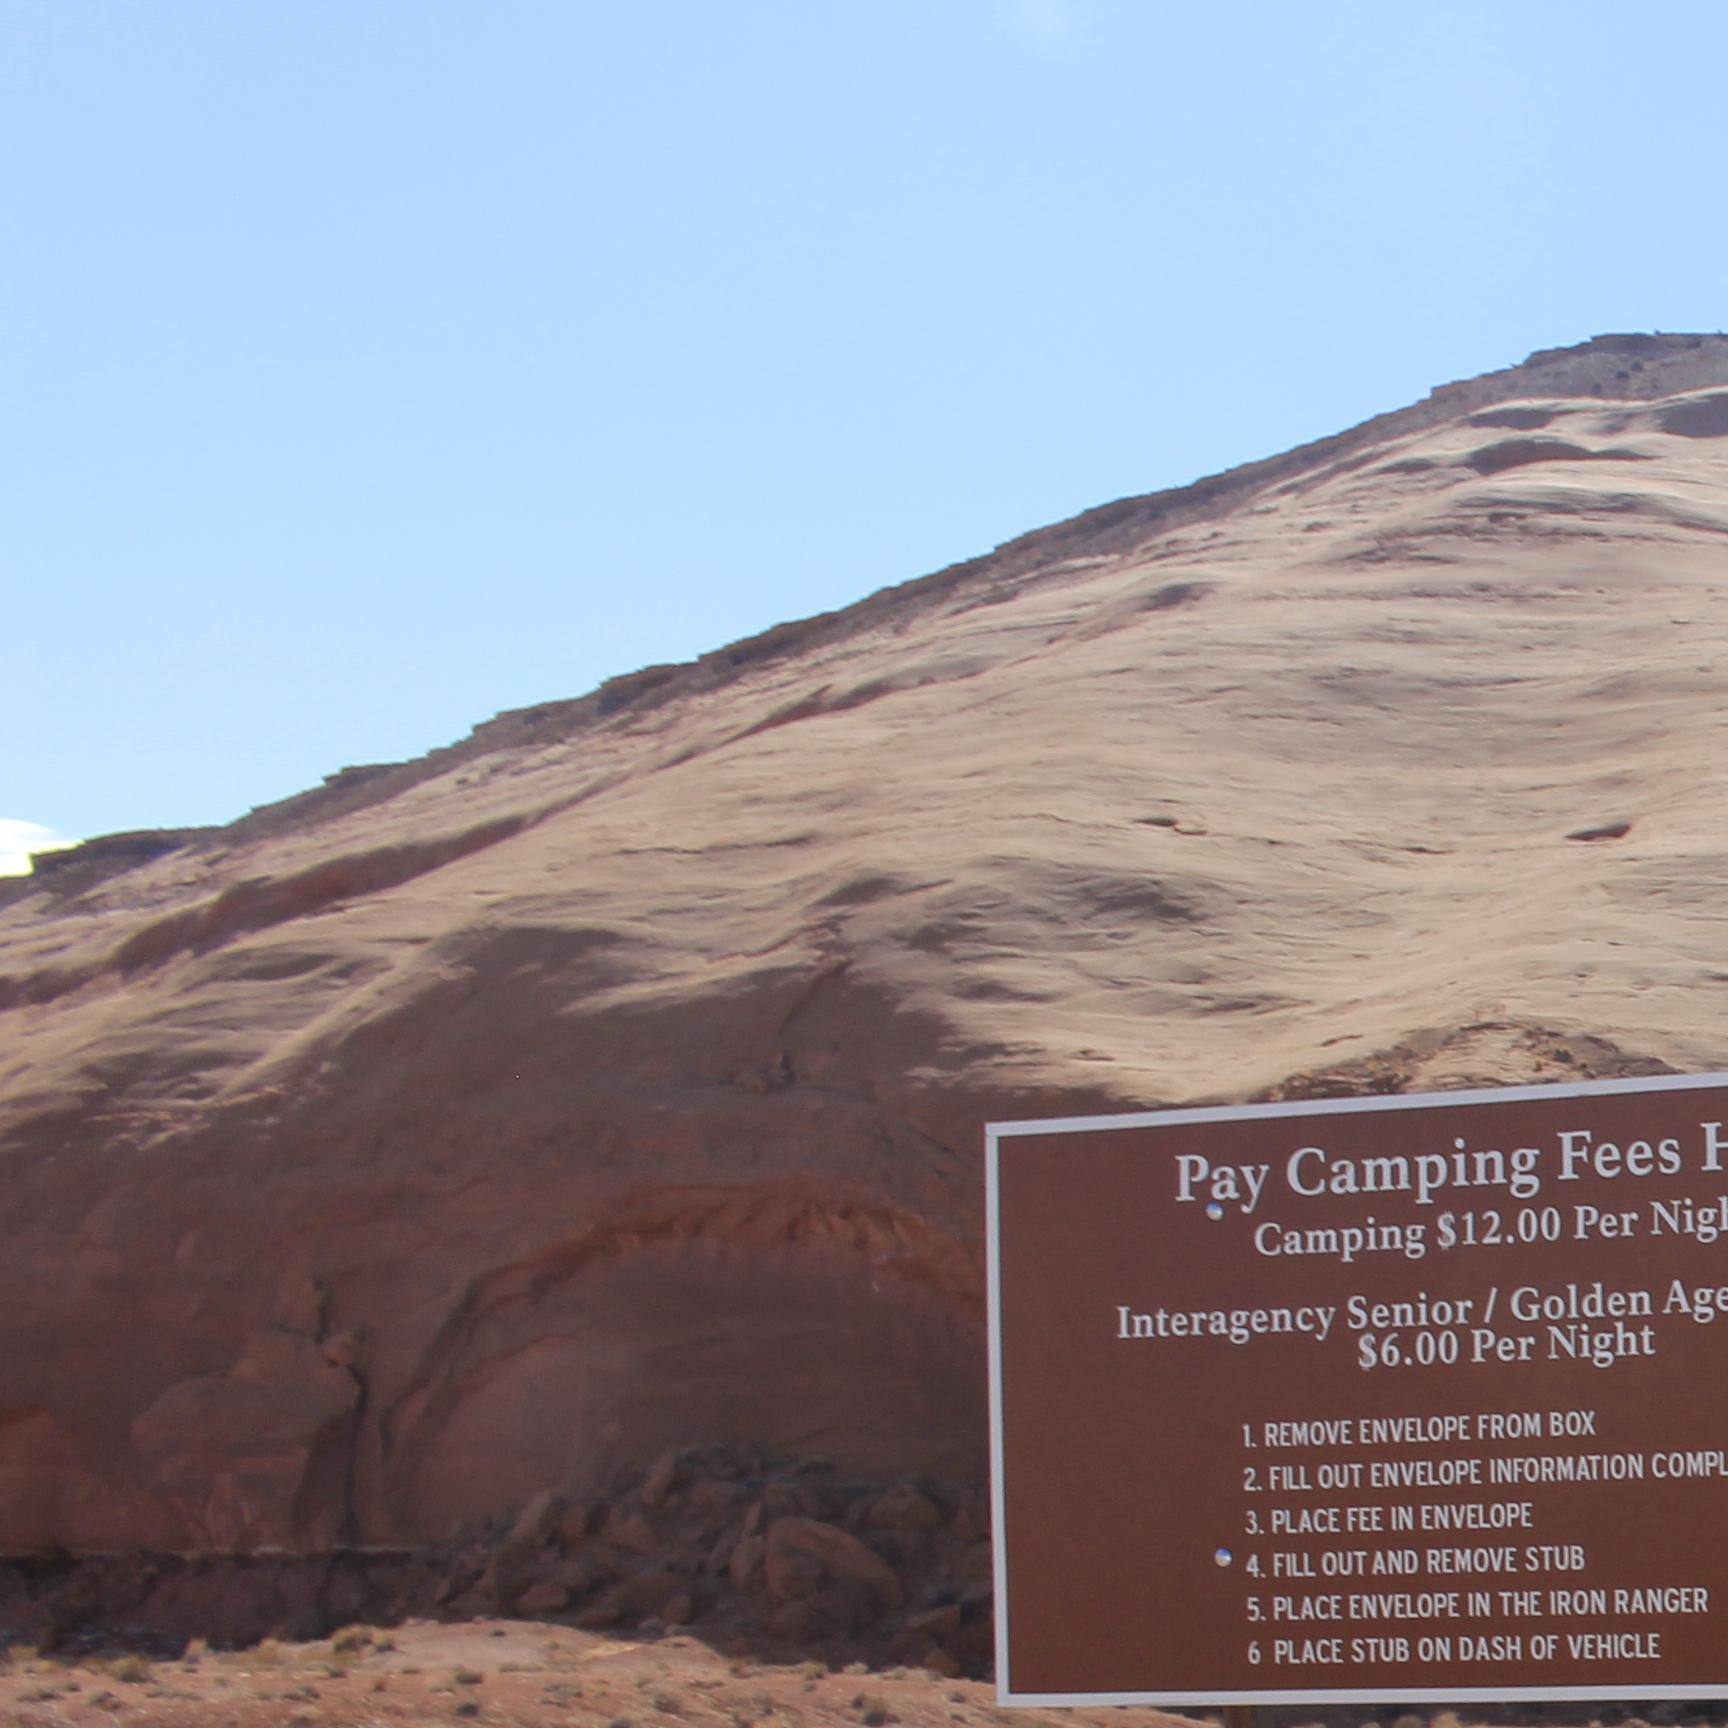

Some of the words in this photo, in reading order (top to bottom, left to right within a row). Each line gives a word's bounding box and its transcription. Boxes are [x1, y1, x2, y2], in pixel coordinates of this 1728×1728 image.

[1175, 1154, 1270, 1214] Pay
[1286, 1137, 1541, 1205] Camping
[1556, 1130, 1681, 1180] Fees
[1254, 1216, 1426, 1263] Camping
[1437, 1206, 1561, 1249] $12.00
[1573, 1205, 1639, 1240] Per
[1117, 1306, 1336, 1345] Interagency
[1347, 1292, 1474, 1330] Senior
[1483, 1287, 1498, 1324] /
[1510, 1282, 1653, 1322] Golden
[1358, 1330, 1458, 1370] $6.00
[1470, 1328, 1536, 1363] Per
[1546, 1321, 1656, 1368] Night
[1242, 1424, 1256, 1448] 1.
[1264, 1420, 1353, 1447] REMOVE
[1359, 1415, 1471, 1444] ENVELOPE
[1477, 1412, 1542, 1440] FROM
[1549, 1410, 1596, 1437] BOX
[1243, 1467, 1263, 1492] 2.
[1269, 1465, 1312, 1491] FILL
[1317, 1463, 1364, 1489] OUT
[1370, 1459, 1482, 1488] ENVELOPE
[1489, 1453, 1644, 1484] INFORMATION
[1245, 1510, 1264, 1535] 3.
[1271, 1507, 1341, 1534] PLACE
[1346, 1506, 1383, 1532] FEE
[1390, 1506, 1414, 1531] IN
[1420, 1502, 1533, 1530] ENVELOPE
[1245, 1554, 1266, 1578] 4.
[1273, 1552, 1316, 1577] FILL
[1321, 1550, 1368, 1576] OUT
[1371, 1549, 1419, 1575] AND
[1426, 1547, 1517, 1574] REMOVE
[1525, 1545, 1585, 1572] STUB
[1247, 1597, 1267, 1622] 5.
[1273, 1595, 1342, 1621] PLACE
[1349, 1592, 1460, 1619] ENVELOPE
[1467, 1592, 1491, 1617] IN
[1498, 1591, 1542, 1616] THE
[1549, 1589, 1606, 1615] IRON
[1614, 1587, 1708, 1614] RANGER
[1248, 1641, 1261, 1665] 6
[1274, 1638, 1344, 1664] PLACE
[1351, 1637, 1410, 1663] STUB
[1417, 1637, 1451, 1662] ON
[1459, 1635, 1522, 1661] DASH
[1530, 1634, 1559, 1660] OF
[1567, 1633, 1661, 1660] VEHICLE
